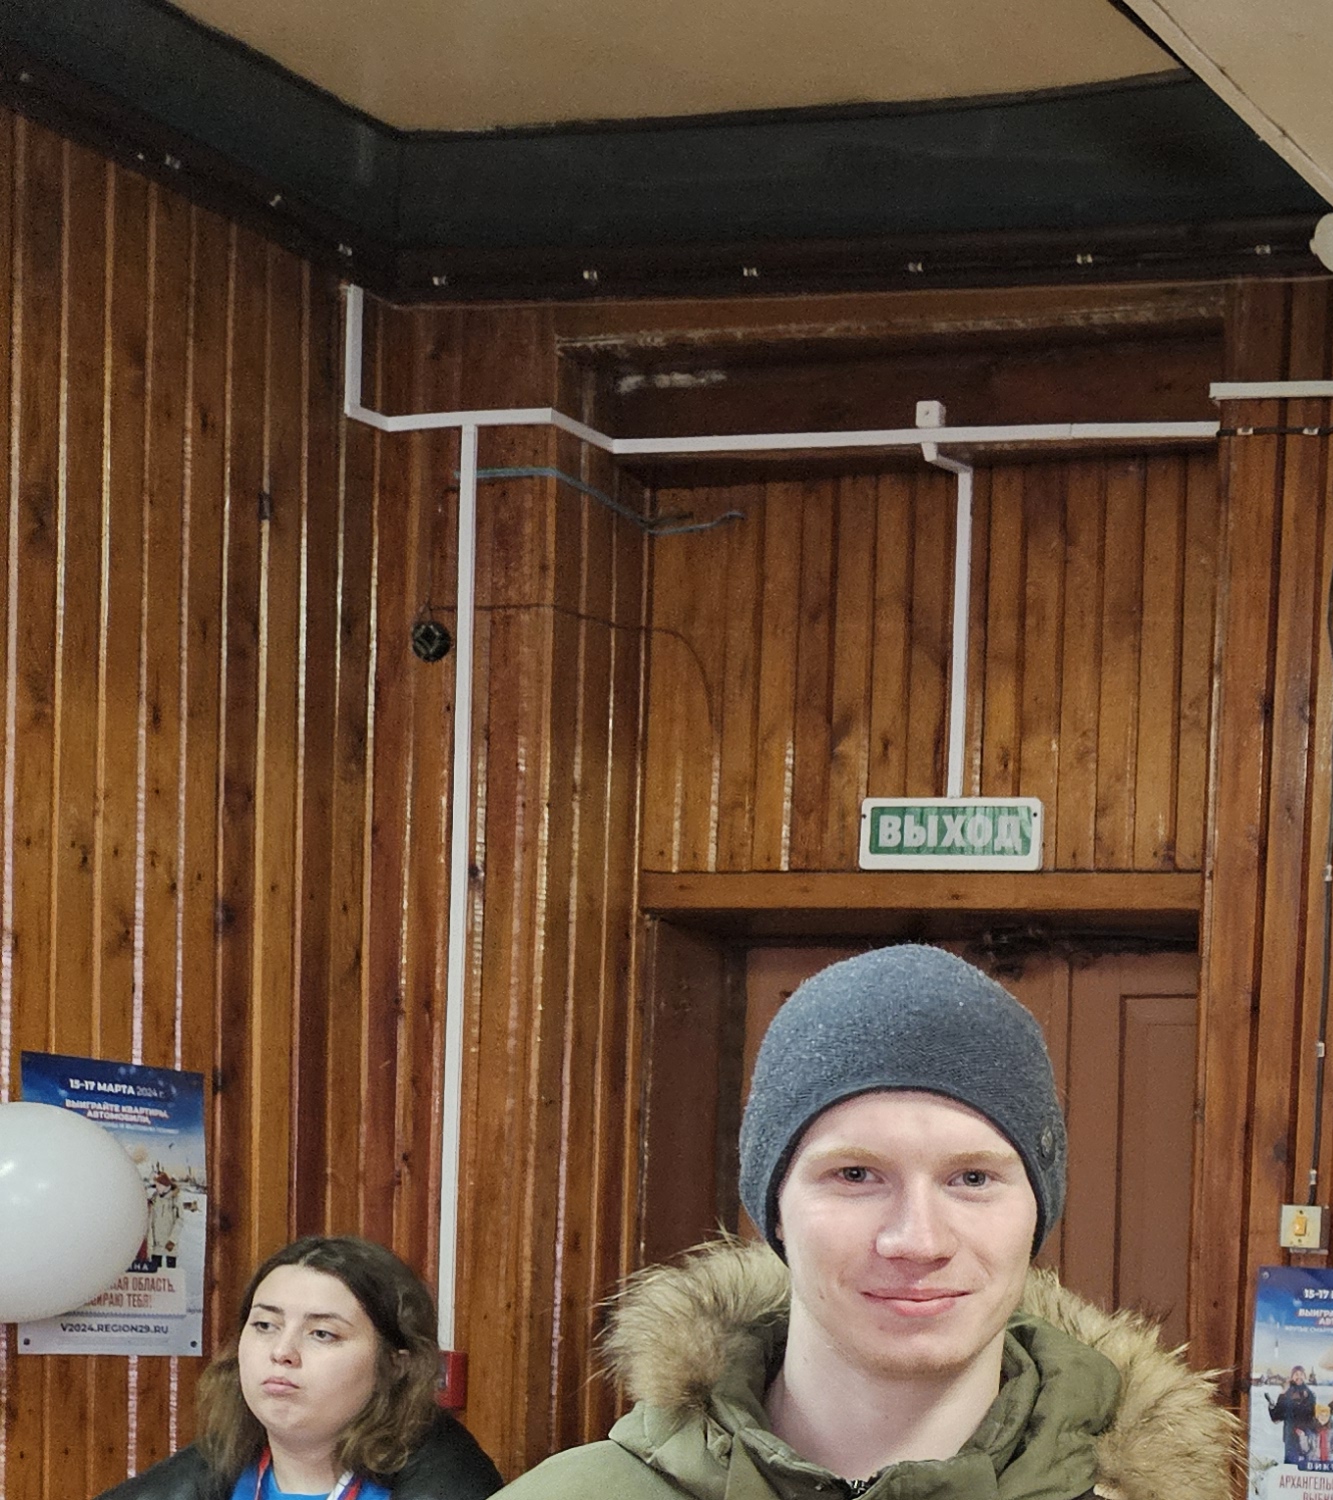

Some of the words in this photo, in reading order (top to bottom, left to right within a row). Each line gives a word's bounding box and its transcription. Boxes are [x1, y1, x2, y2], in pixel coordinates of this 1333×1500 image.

[878, 814, 1022, 851] ВЫХОД
[97, 1081, 135, 1095] МАРТА
[1303, 1288, 1330, 1299] 15-17
